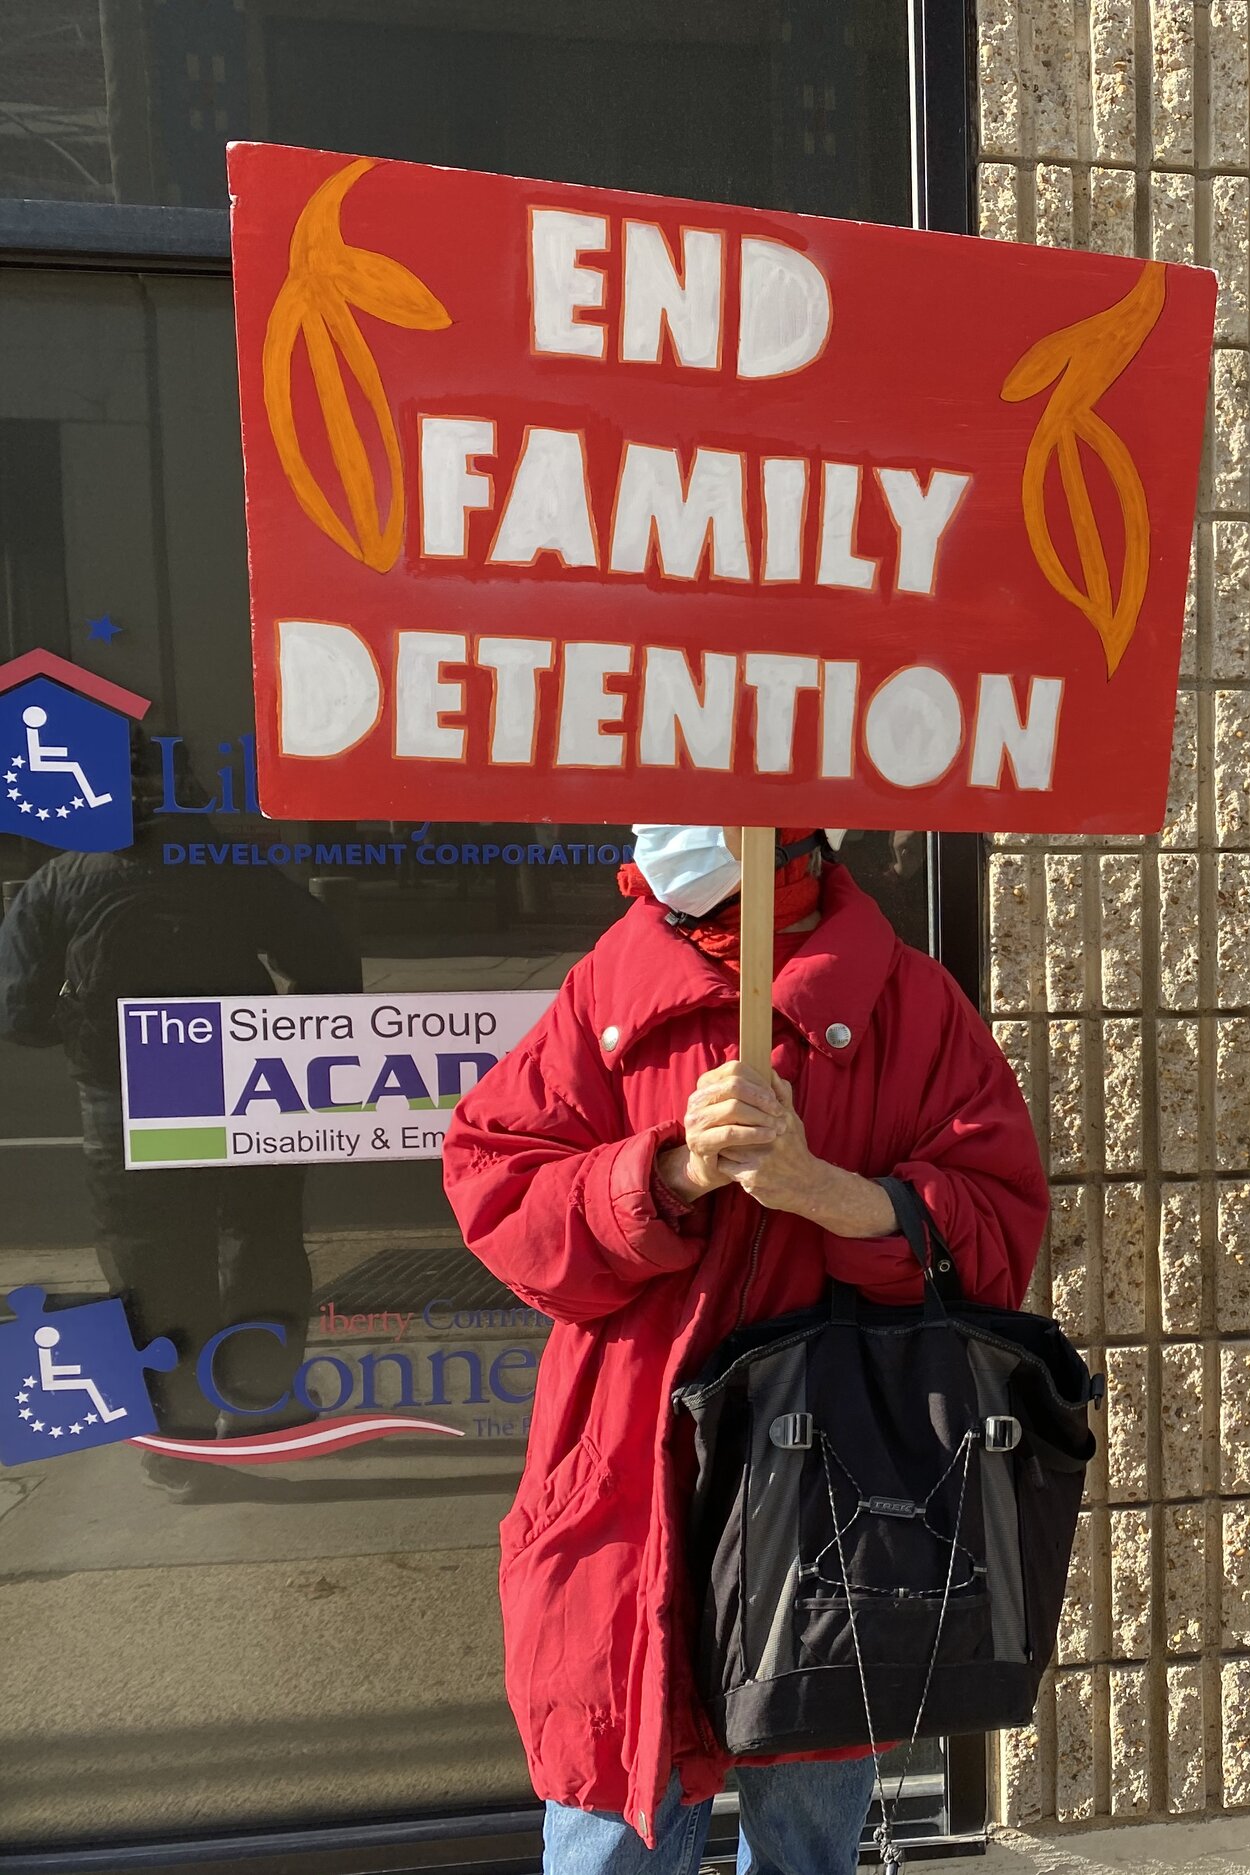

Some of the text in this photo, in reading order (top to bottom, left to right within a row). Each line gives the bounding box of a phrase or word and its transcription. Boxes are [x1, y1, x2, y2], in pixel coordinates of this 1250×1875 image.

[529, 206, 832, 380] END
[417, 414, 972, 596] FAMILY
[275, 619, 1065, 792] DETENTION
[163, 843, 407, 865] DEVELOPMENT
[128, 1005, 497, 1045] The Sierra Group
[230, 1052, 510, 1116] ACAD
[232, 1128, 361, 1157] Disability
[370, 1127, 391, 1150] &
